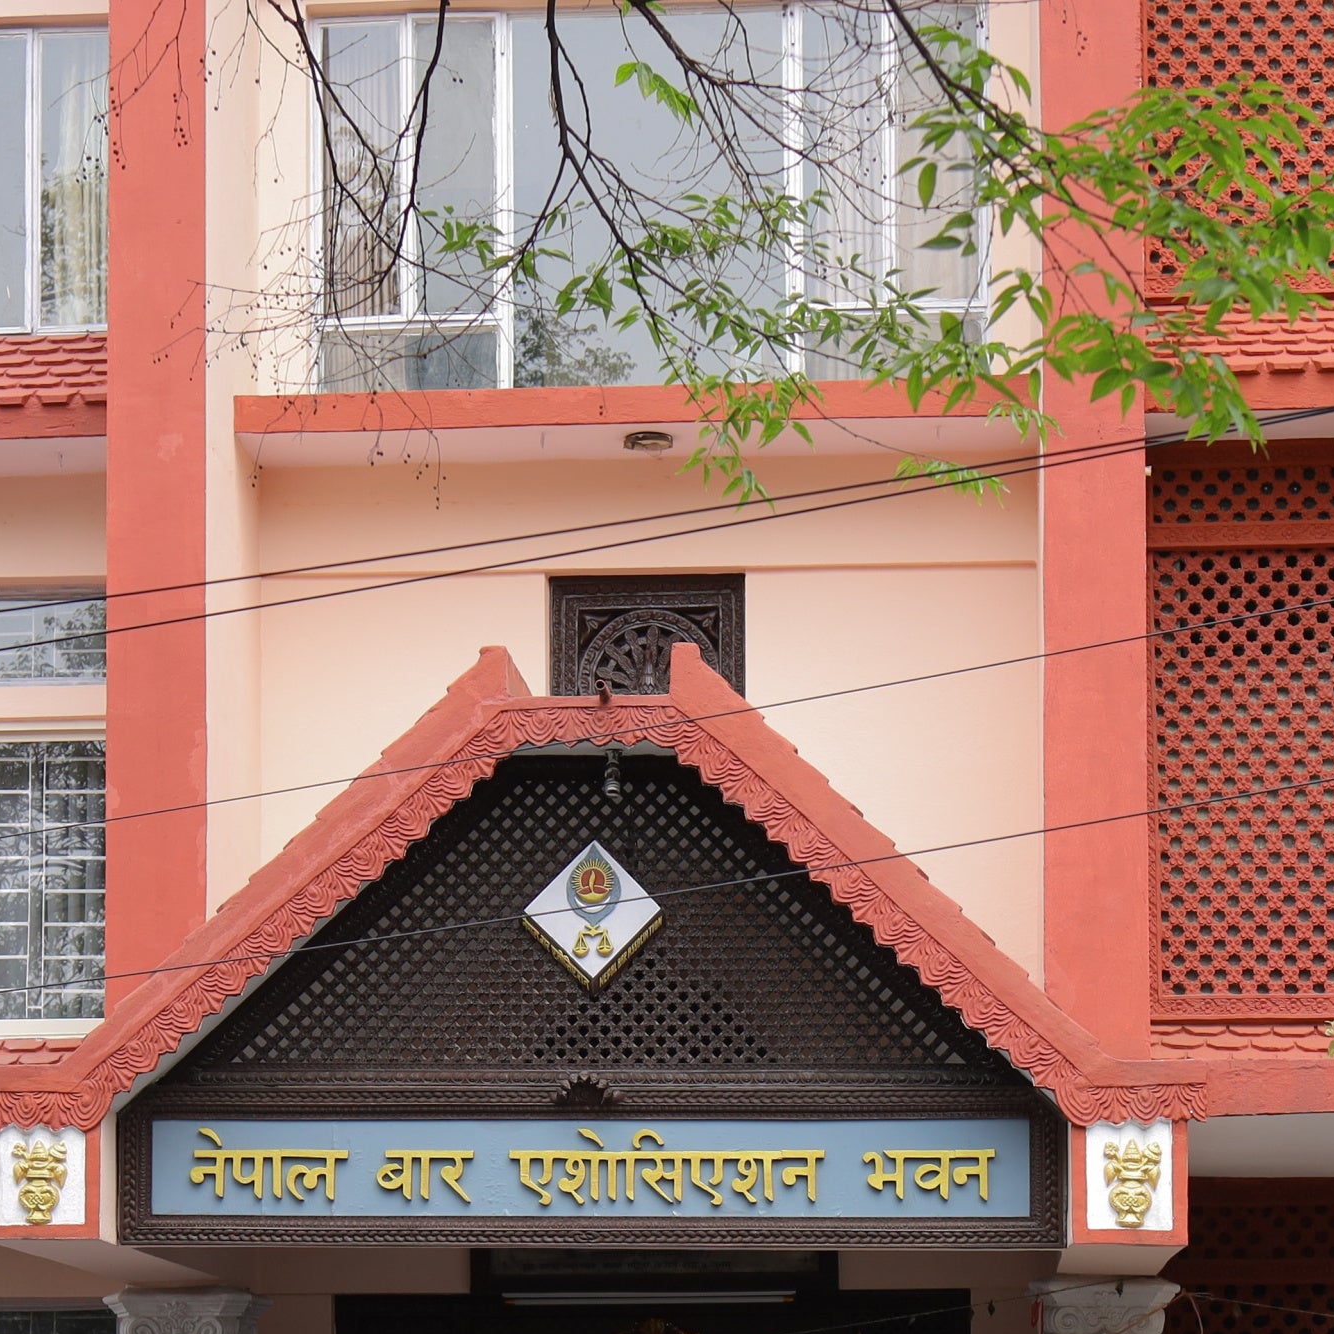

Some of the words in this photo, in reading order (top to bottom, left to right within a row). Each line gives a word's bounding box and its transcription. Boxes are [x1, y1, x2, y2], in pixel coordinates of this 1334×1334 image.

[189, 1127, 349, 1201] नेपाल
[376, 1150, 474, 1203] बार
[508, 1128, 825, 1206] एशोसिएशन
[862, 1149, 996, 1201] भवन
